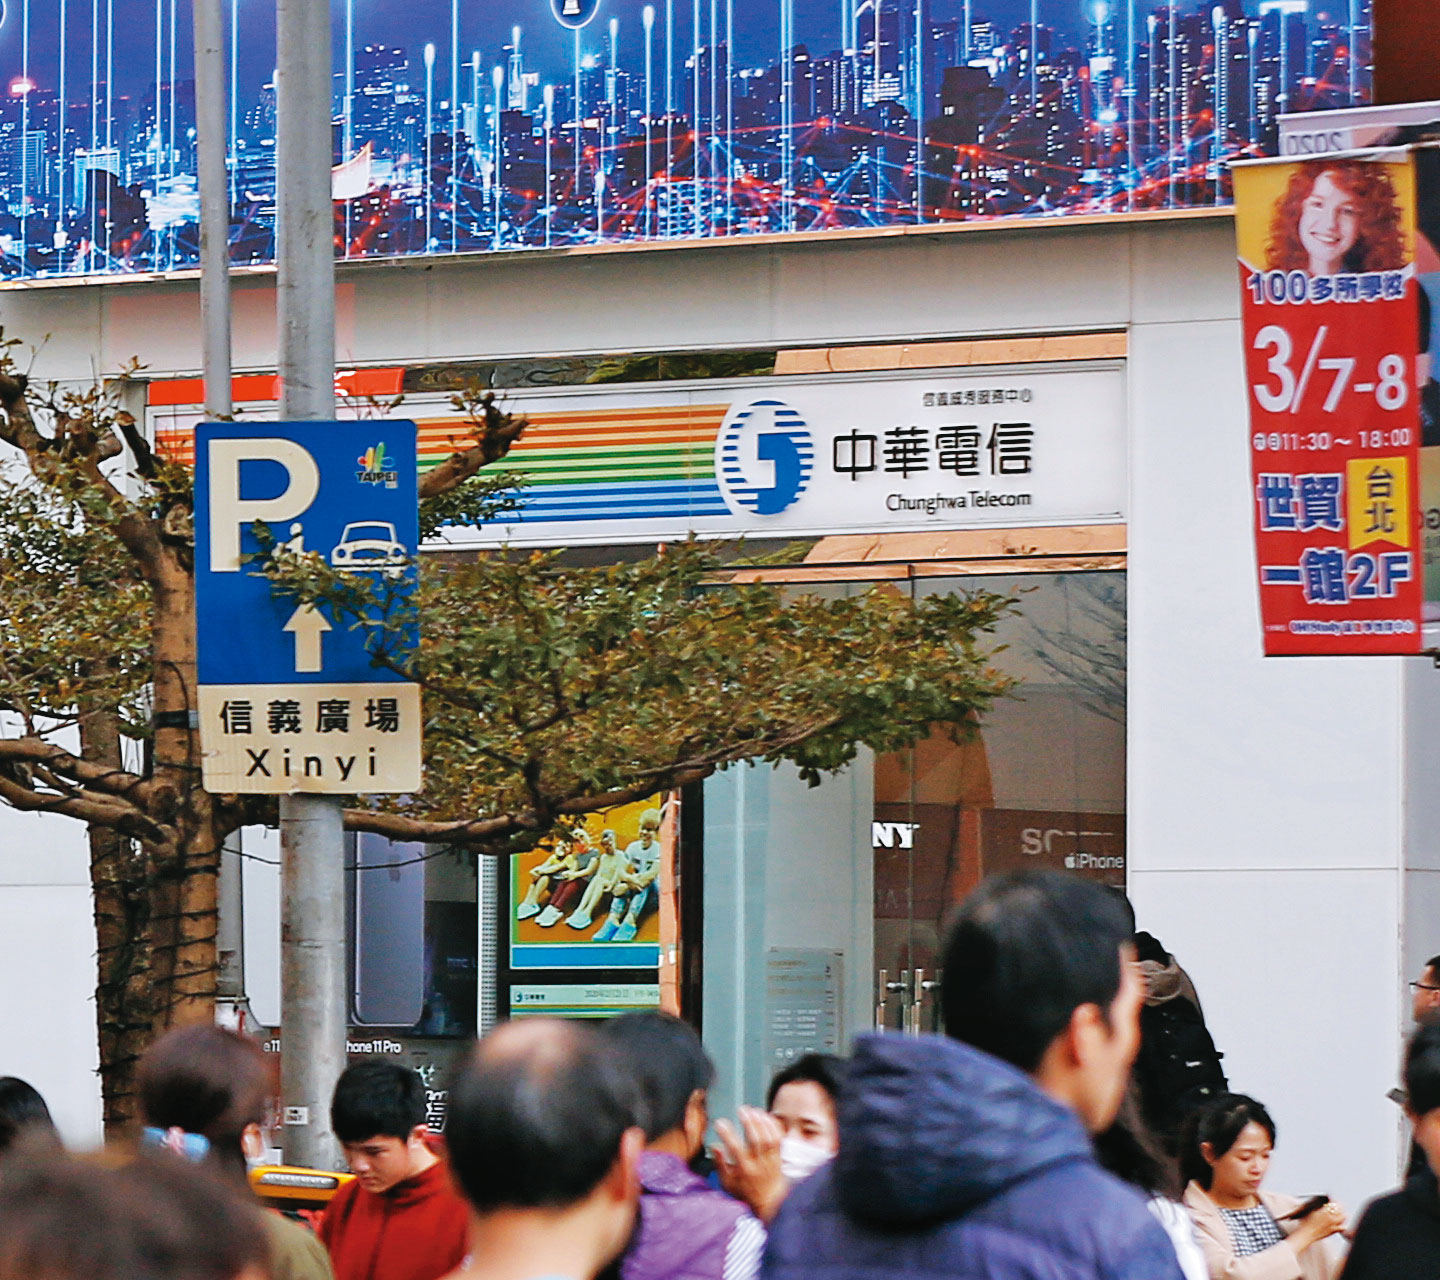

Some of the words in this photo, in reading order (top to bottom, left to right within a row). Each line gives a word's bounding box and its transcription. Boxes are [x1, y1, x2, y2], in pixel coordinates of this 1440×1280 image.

[833, 422, 1034, 481] 中華電信
[208, 437, 321, 572] P
[885, 493, 967, 515] Chunghwa
[967, 490, 1032, 508] Telecom
[1256, 472, 1345, 533] 世貿
[1363, 465, 1396, 534] 台北
[218, 698, 401, 735] 信義廣場
[245, 746, 377, 781] Xinyi
[1075, 853, 1125, 869] iPhone
